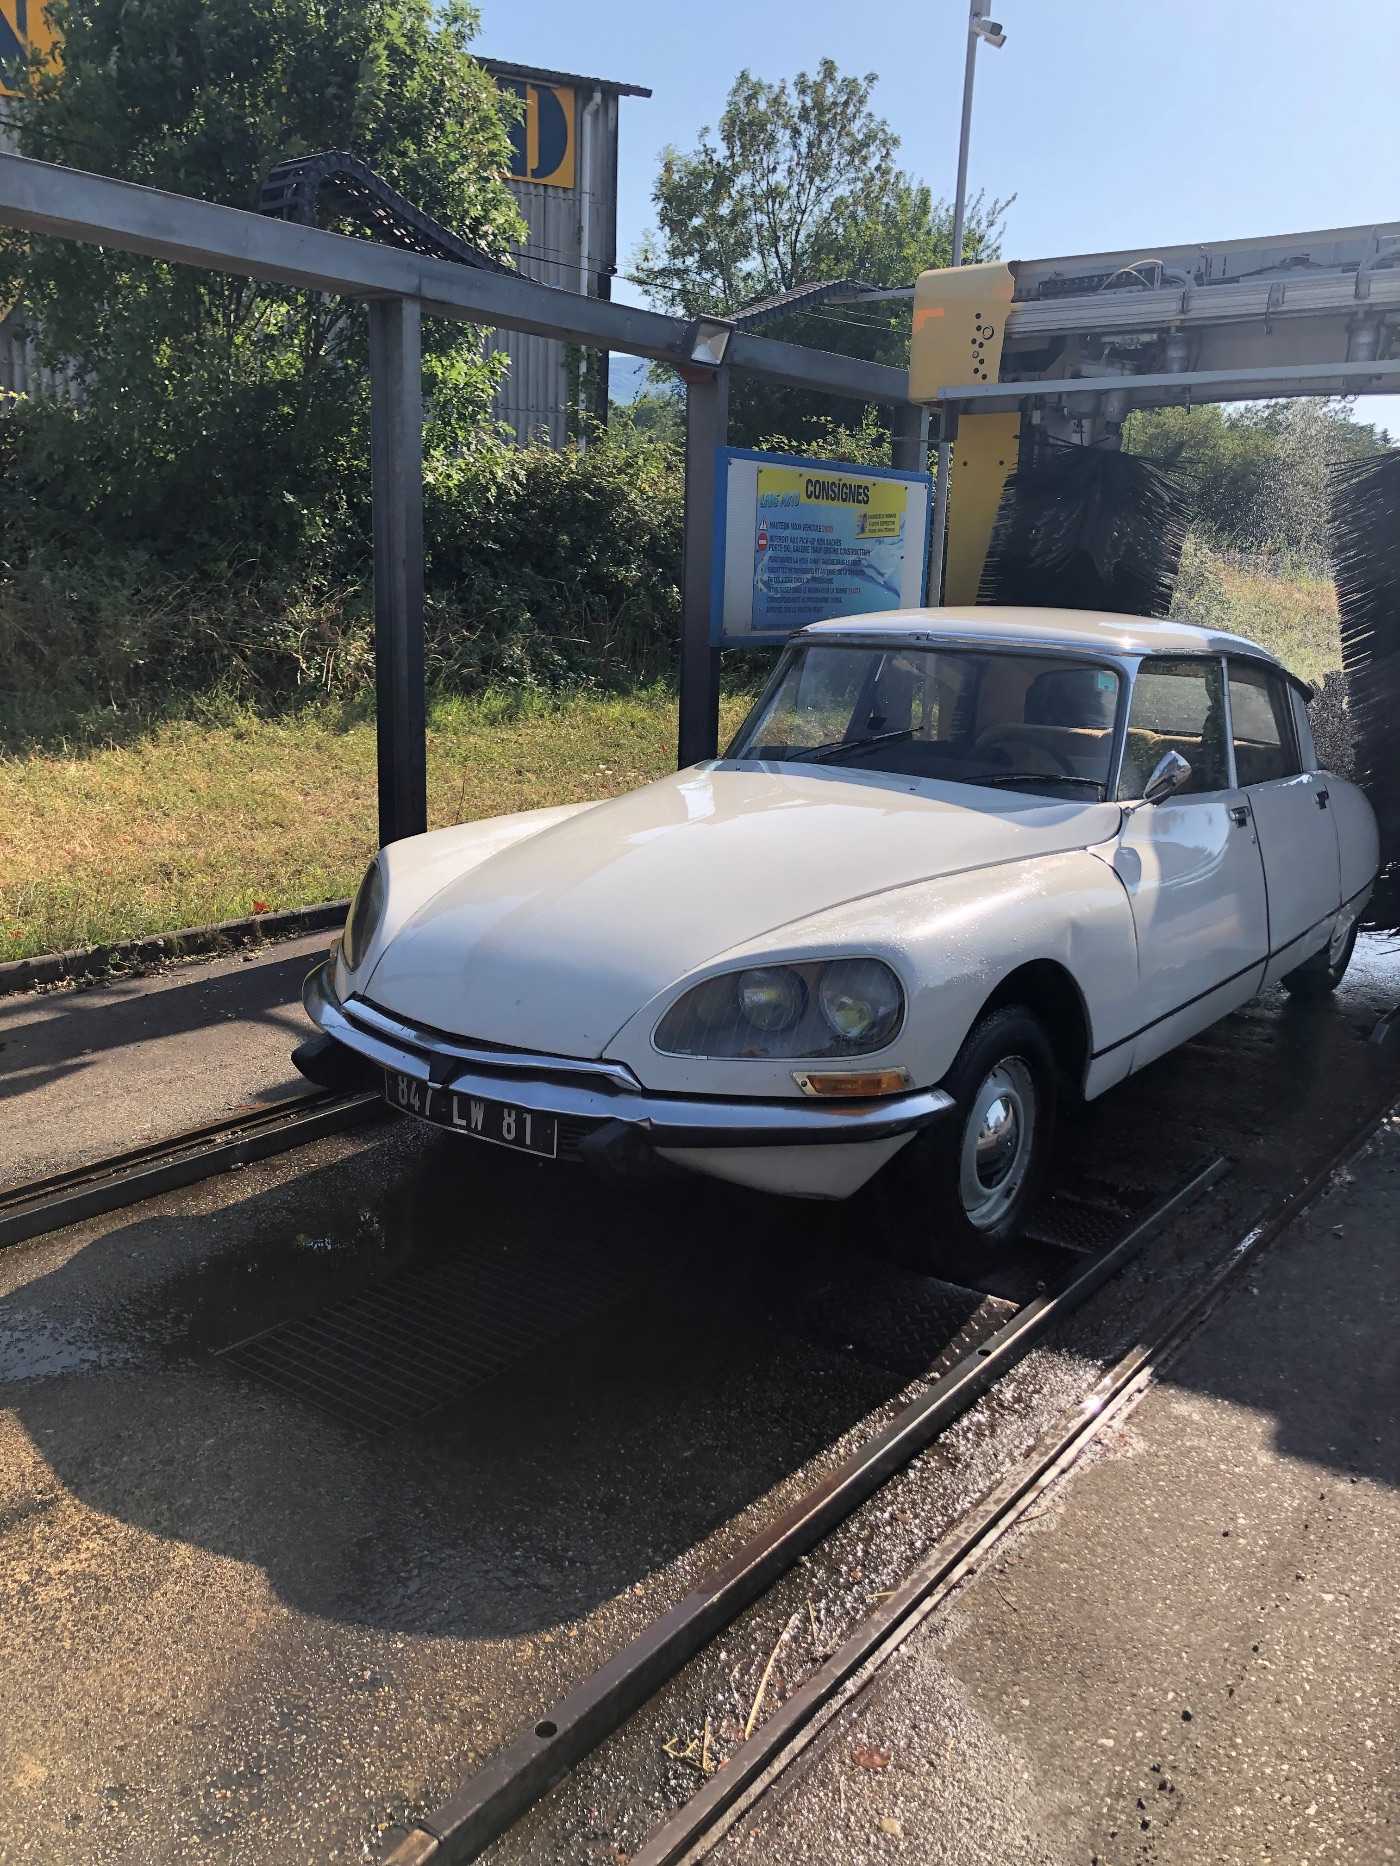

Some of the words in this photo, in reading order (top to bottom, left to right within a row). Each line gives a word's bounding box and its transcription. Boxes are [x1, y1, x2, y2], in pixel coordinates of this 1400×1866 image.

[805, 479, 870, 505] CONSIGNES
[452, 1096, 485, 1131] LW
[502, 1108, 533, 1145] 81
